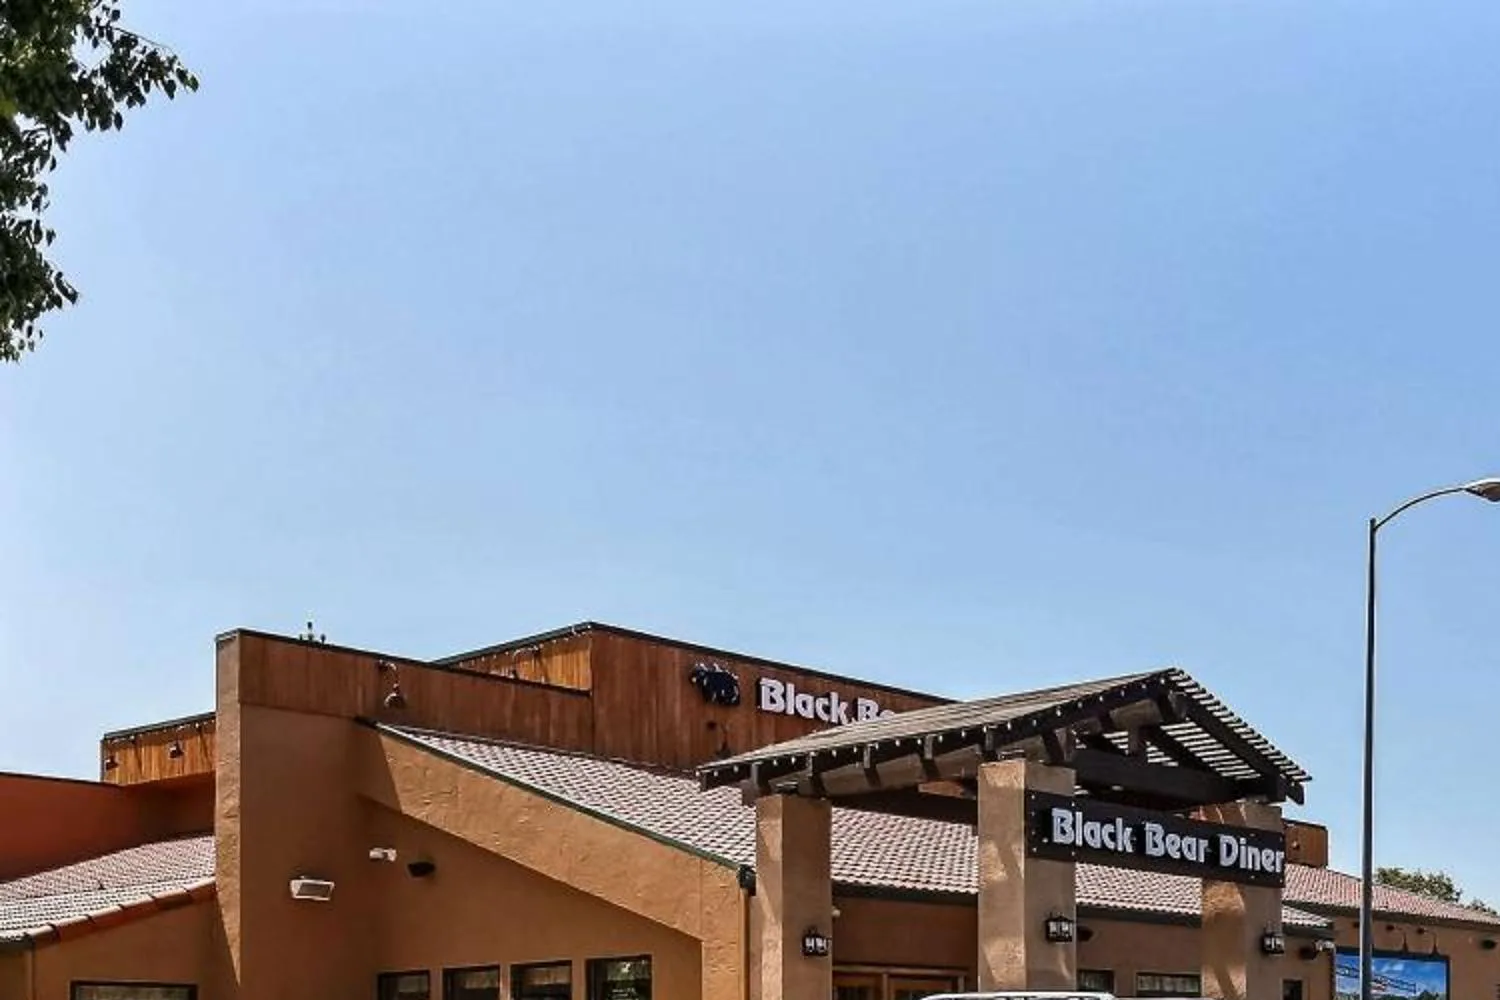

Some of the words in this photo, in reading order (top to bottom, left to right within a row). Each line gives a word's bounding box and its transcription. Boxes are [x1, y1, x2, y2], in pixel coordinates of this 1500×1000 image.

[759, 677, 850, 726] Black
[1051, 807, 1134, 853] Black
[1144, 822, 1209, 863] Bear
[1218, 833, 1285, 873] Diner
